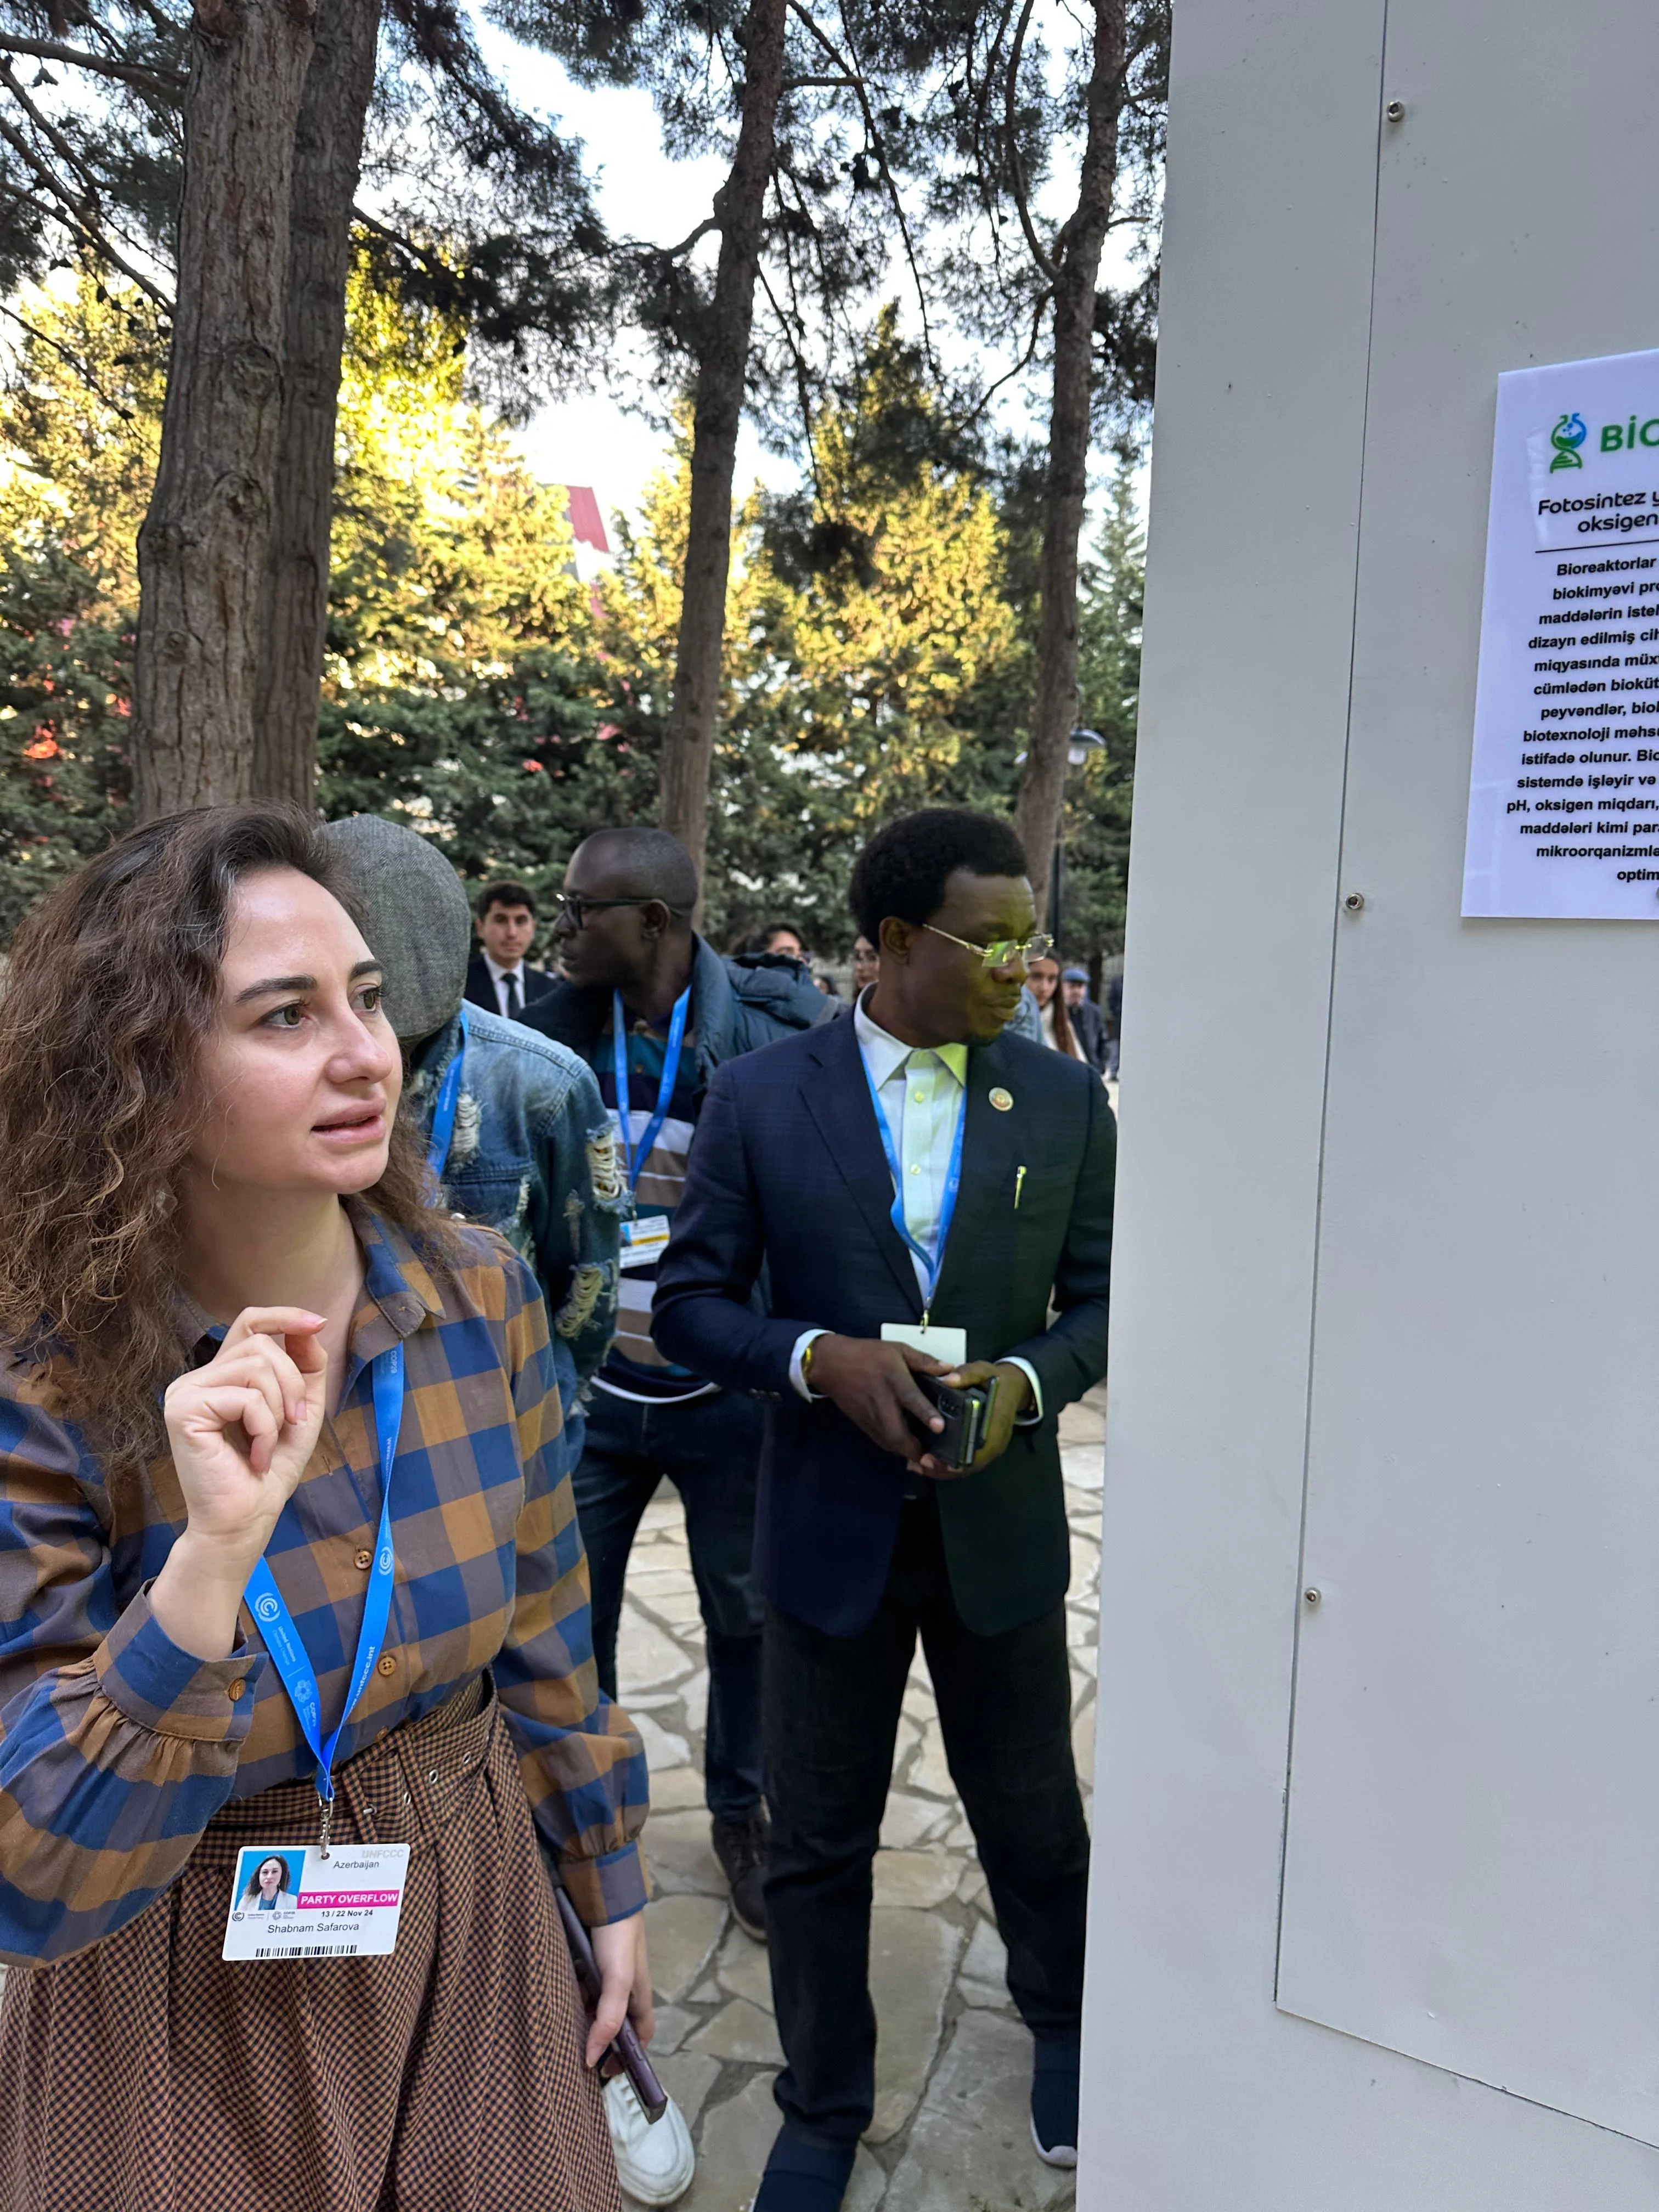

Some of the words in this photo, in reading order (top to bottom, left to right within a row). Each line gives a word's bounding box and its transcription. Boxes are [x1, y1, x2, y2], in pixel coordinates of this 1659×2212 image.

[1538, 492, 1646, 517] Fotosintez
[1577, 513, 1659, 533] oksigen
[1556, 557, 1657, 576] Bioreaktorlar
[1553, 581, 1635, 600] biokimyəvi
[1539, 607, 1623, 625] maddələrin
[1528, 636, 1576, 650] dizayn
[1580, 630, 1635, 646] edilmiş
[1534, 656, 1620, 674] miqyasında
[1624, 653, 1659, 667] müx
[1533, 680, 1606, 695] cümlədən
[1541, 703, 1627, 721] peyvəndlər,
[1523, 727, 1610, 742] biotexnoloji
[1614, 725, 1659, 739] məhs
[1521, 752, 1575, 765] istifadə
[1579, 751, 1632, 764] olunur.
[1517, 775, 1584, 788] sistemdə
[1588, 774, 1635, 789] işləyir
[1638, 776, 1656, 786] və
[1506, 799, 1531, 814] pH,
[1535, 799, 1593, 814] oksigen
[1598, 797, 1659, 812] miqdarı,
[1520, 821, 1593, 834] maddələri
[1596, 821, 1628, 833] kimi
[1632, 823, 1659, 836] par
[362, 1849, 404, 1859] UNFCCC
[334, 1860, 380, 1870] Azerbaijan
[301, 1895, 337, 1905] PARTY
[338, 1893, 398, 1904] OVERFLOW
[267, 1923, 314, 1933] Shabnam
[317, 1922, 359, 1932] Safarova
